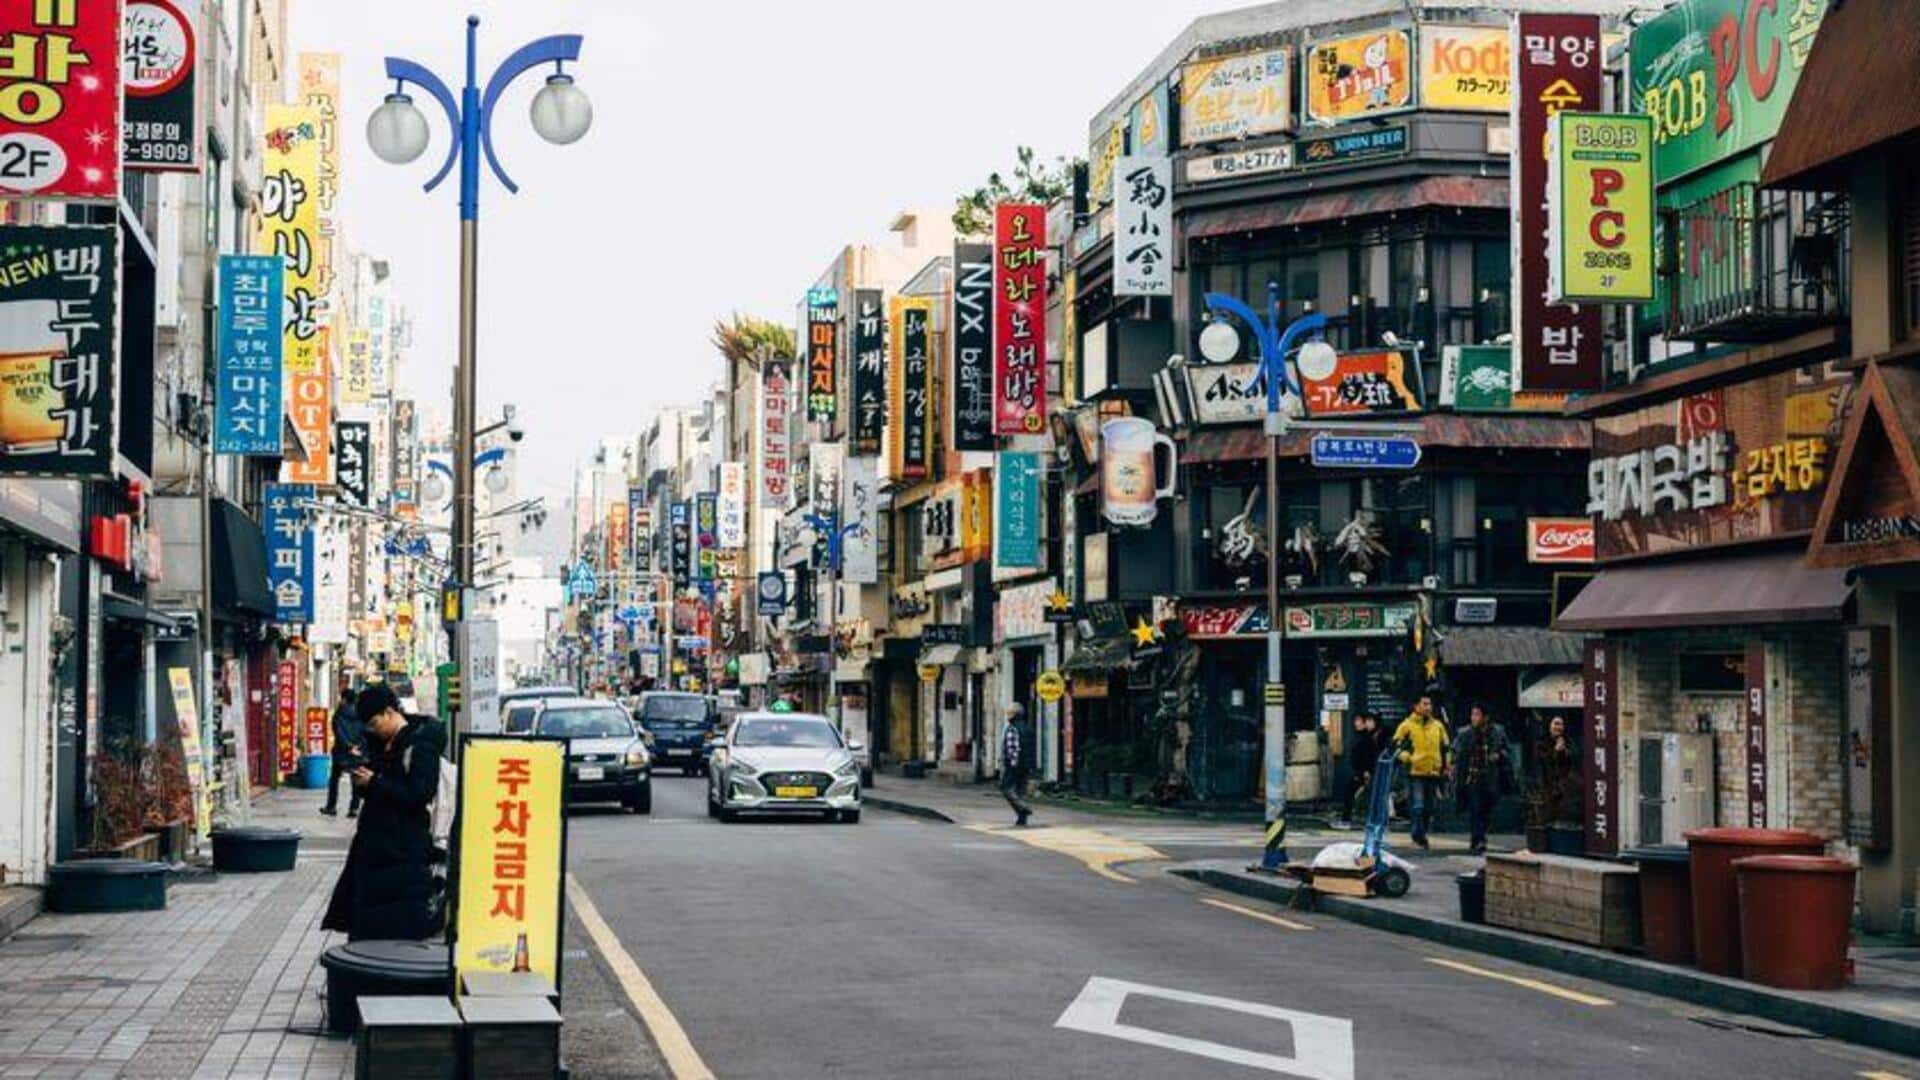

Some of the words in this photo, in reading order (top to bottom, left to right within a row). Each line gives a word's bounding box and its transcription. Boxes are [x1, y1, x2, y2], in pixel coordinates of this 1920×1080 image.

[1525, 35, 1597, 67] 밀양
[1709, 0, 1781, 138] PC
[1, 141, 51, 178] 2F
[1575, 124, 1637, 148] B.O.B
[1588, 168, 1626, 250] PC
[956, 262, 992, 334] Nyx
[50, 246, 100, 456] 백두대간
[812, 324, 835, 393] 마사지
[1005, 312, 1038, 409] 노래방
[231, 375, 270, 437] 마사지
[297, 379, 324, 475] OTEL
[1586, 431, 1727, 521] 돼지국밥
[1746, 438, 1826, 497] 감자탕
[489, 757, 533, 922] 주차금지
